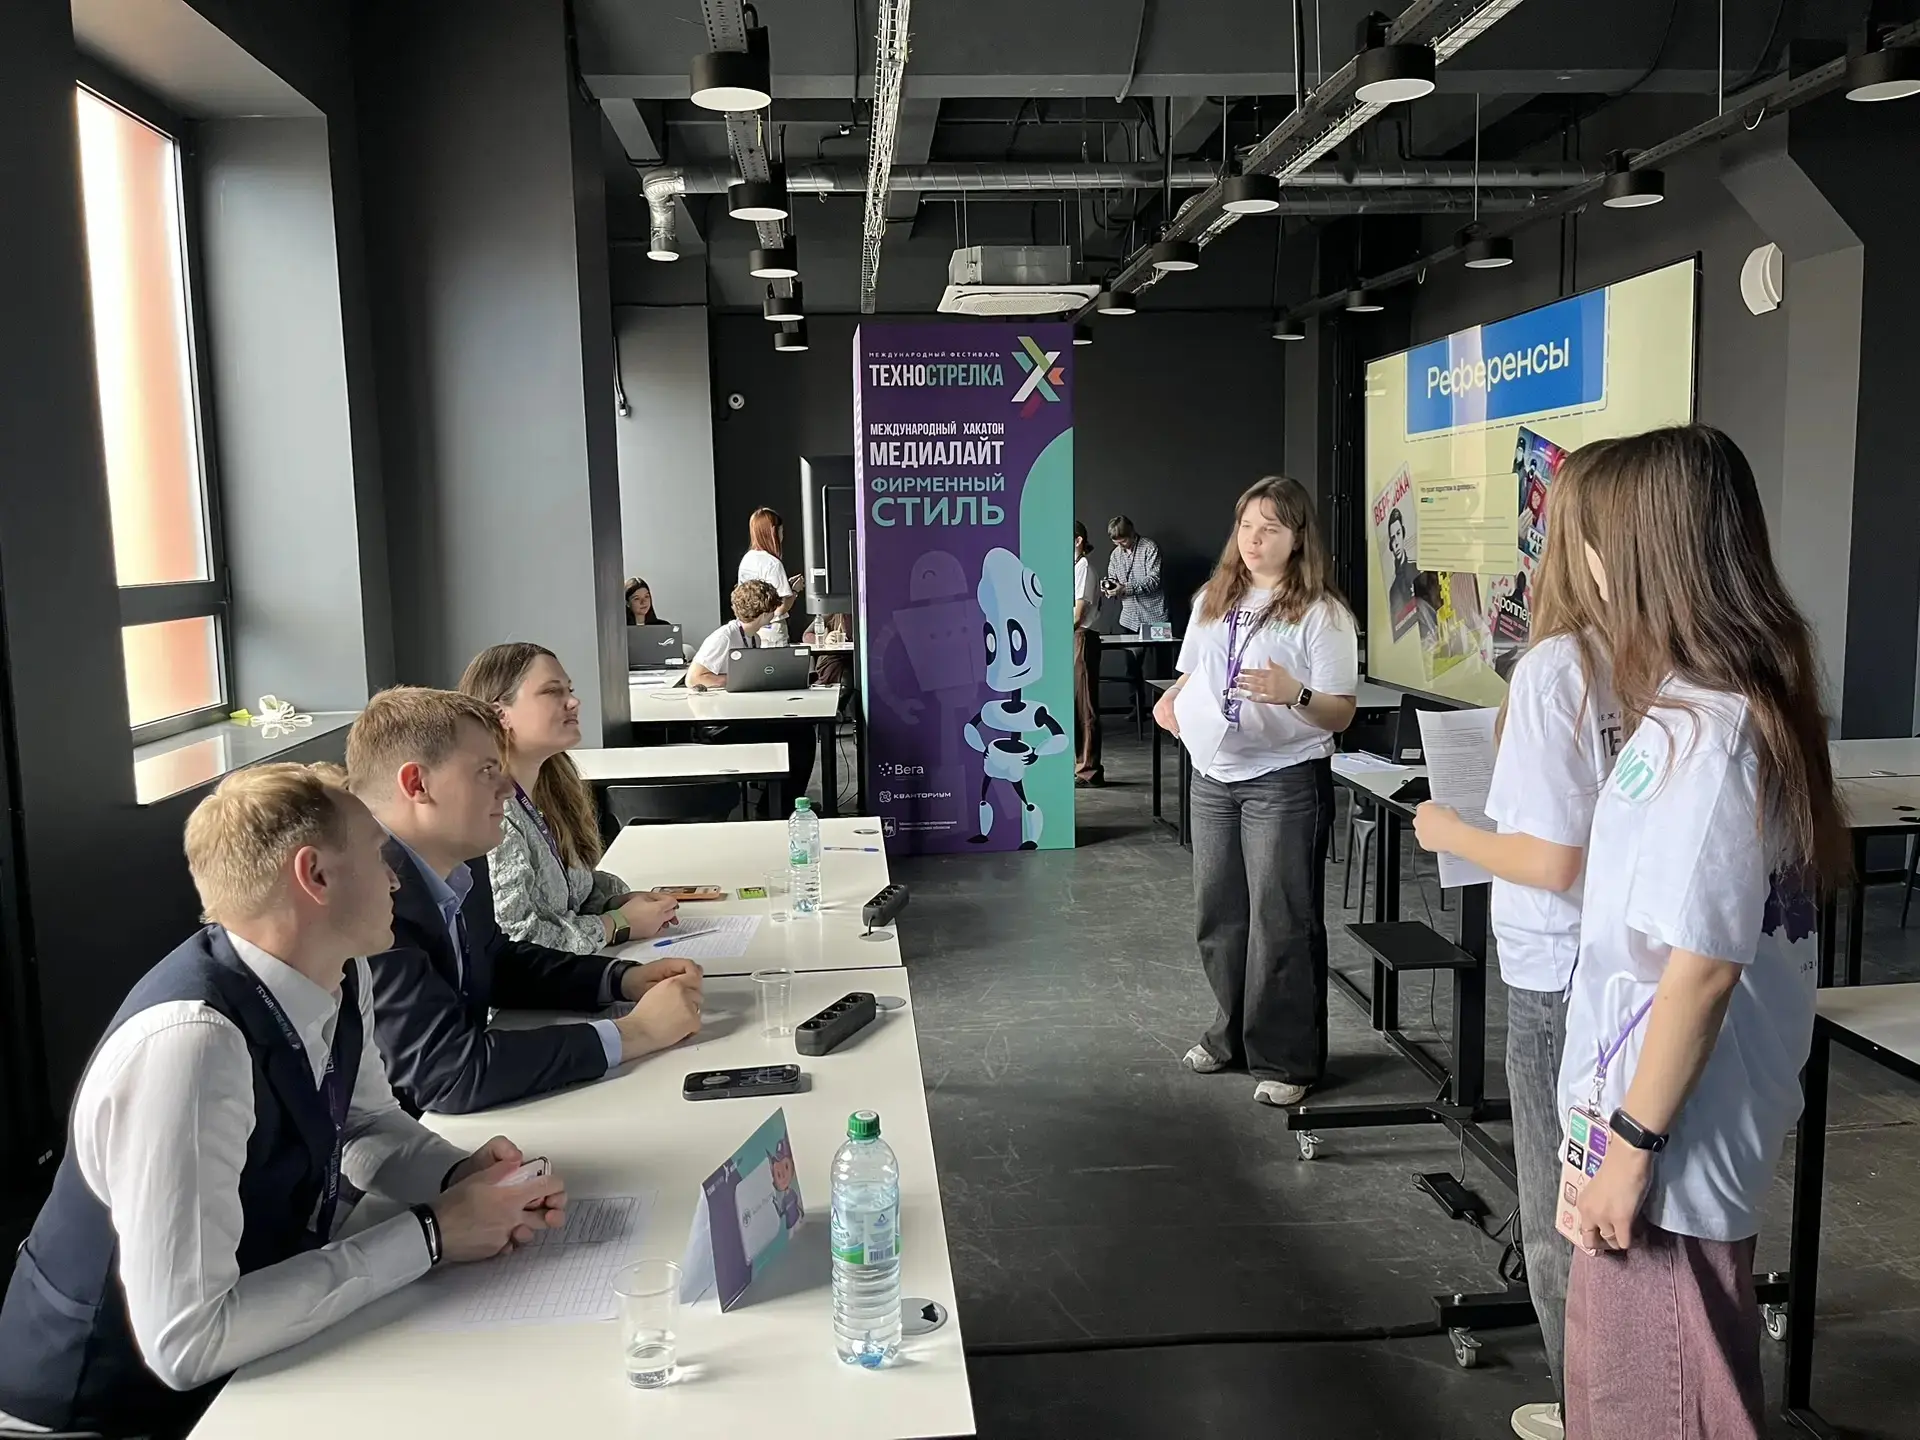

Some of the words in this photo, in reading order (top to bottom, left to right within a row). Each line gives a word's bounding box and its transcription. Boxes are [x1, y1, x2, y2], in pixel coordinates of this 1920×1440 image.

[868, 363, 1004, 387] ТЕХНОСТРЕЛКА
[1428, 337, 1570, 399] Референсы
[869, 420, 957, 436] МЕЖДУНАРОДНЫЙ
[963, 422, 1005, 436] ХАКАТОН
[869, 436, 1005, 469] МЕДИАЛАЙТ
[871, 472, 1005, 493] ФИРМЕННЫЙ
[871, 496, 1006, 527] СТИЛЬ
[894, 763, 924, 775] Вега
